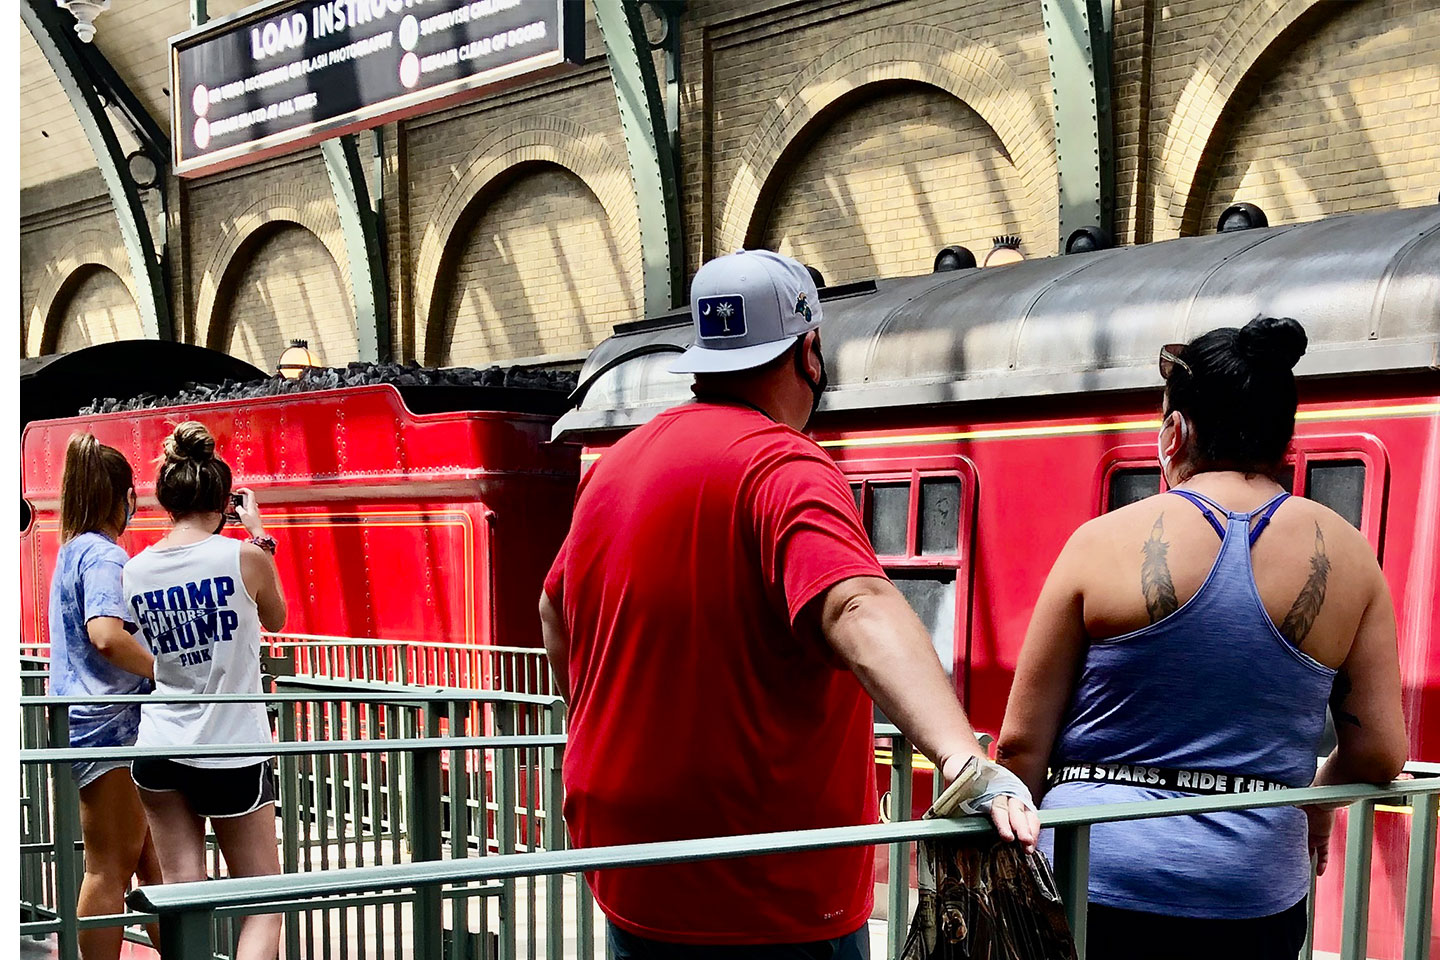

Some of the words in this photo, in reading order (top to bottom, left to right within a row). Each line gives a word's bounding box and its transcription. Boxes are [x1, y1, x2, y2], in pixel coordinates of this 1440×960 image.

[251, 13, 307, 60] LOAD
[313, 0, 423, 38] INSTRU
[459, 38, 491, 60] CLEAR
[492, 32, 507, 50] OF
[508, 21, 546, 47] DOORS
[302, 53, 327, 74] FLASH
[329, 31, 392, 65] PHOTOGRAPHY
[131, 576, 235, 624] CHOMP
[146, 609, 205, 637] GATORS
[179, 649, 212, 667] PINK
[1062, 765, 1091, 781] THE
[1093, 764, 1166, 785] STARS.
[1177, 770, 1228, 792] RIDE
